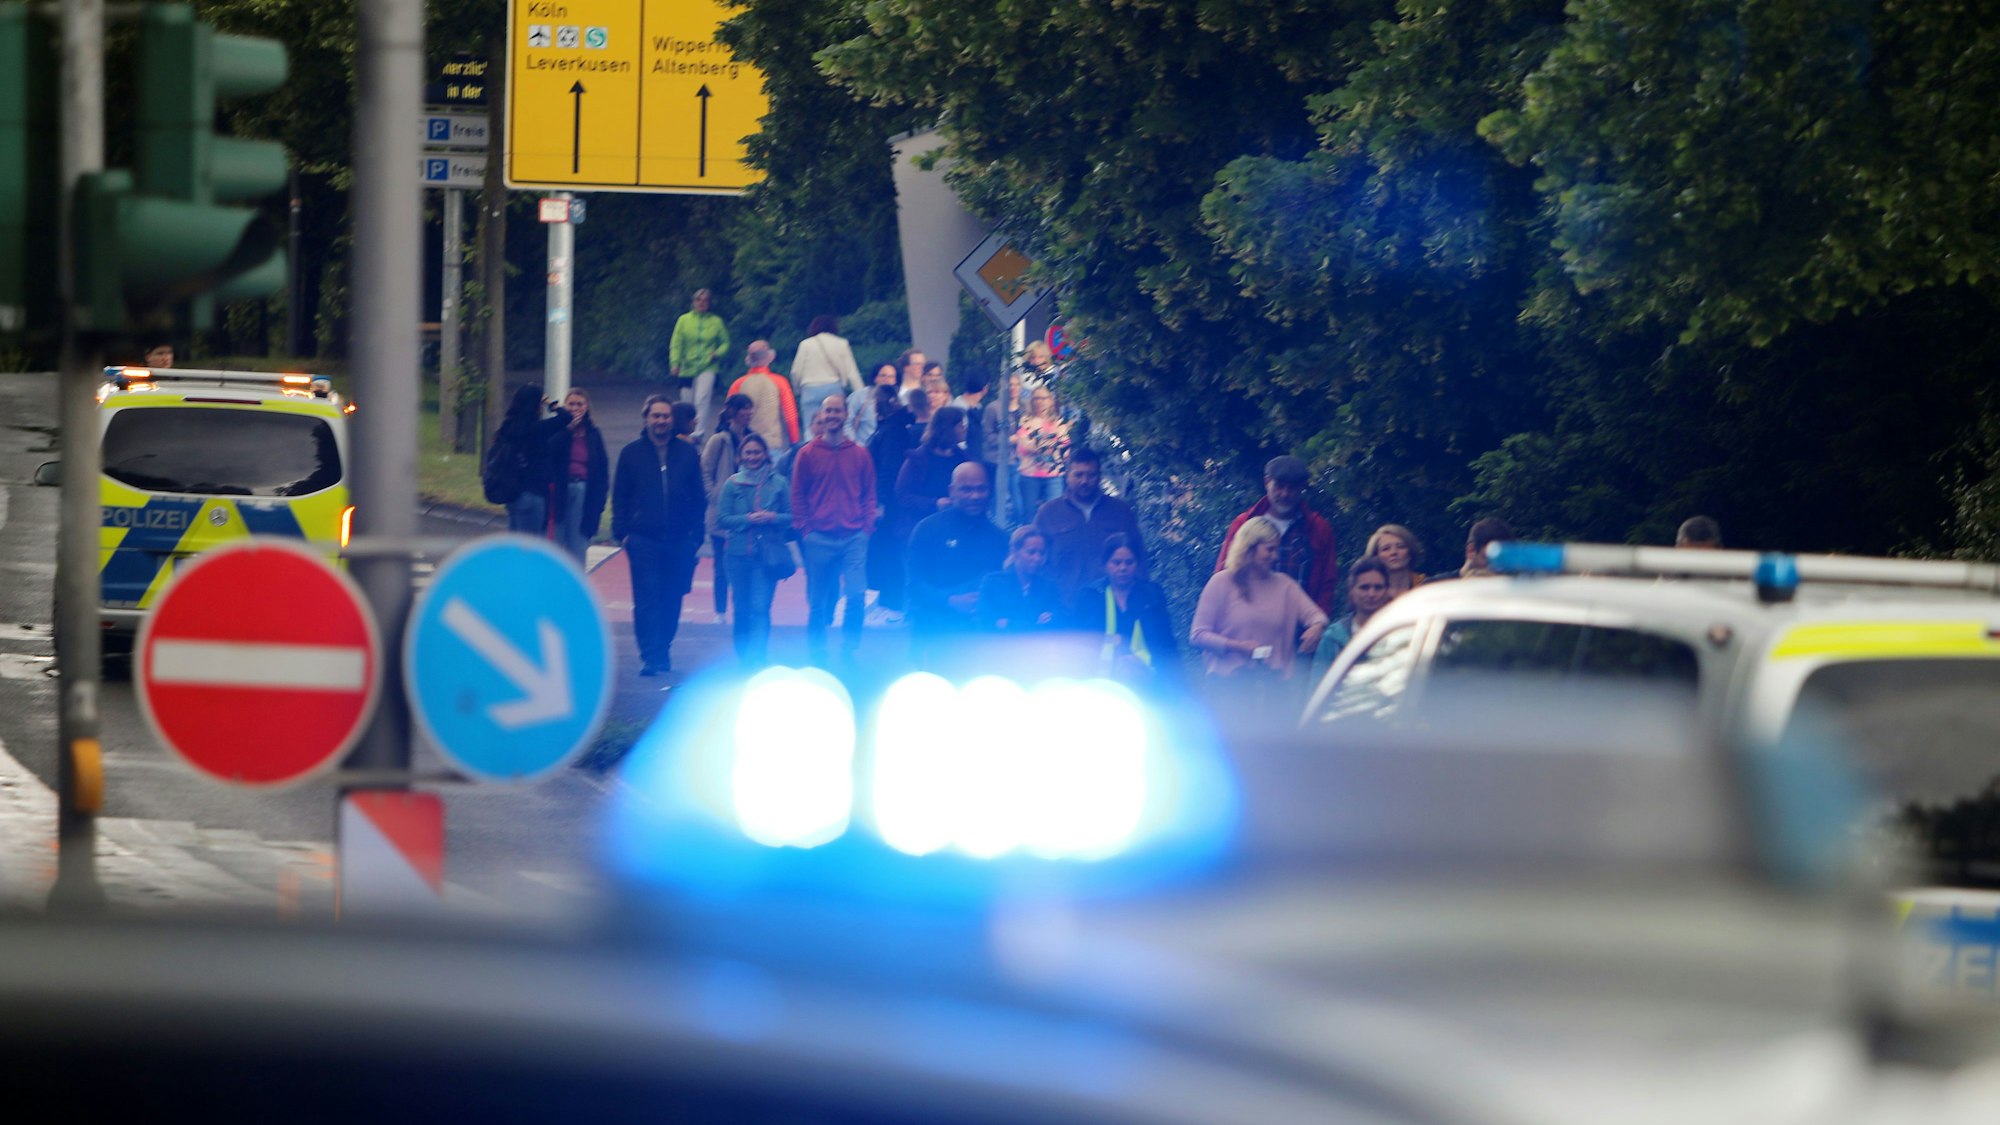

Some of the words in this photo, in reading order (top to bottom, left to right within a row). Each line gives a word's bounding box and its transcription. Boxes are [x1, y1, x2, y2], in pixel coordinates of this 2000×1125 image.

[527, 1, 568, 18] Köln
[526, 54, 631, 73] Leverkusen
[652, 58, 739, 80] Altenberg
[446, 83, 460, 99] in
[461, 83, 484, 99] der
[101, 508, 188, 529] POLIZEI
